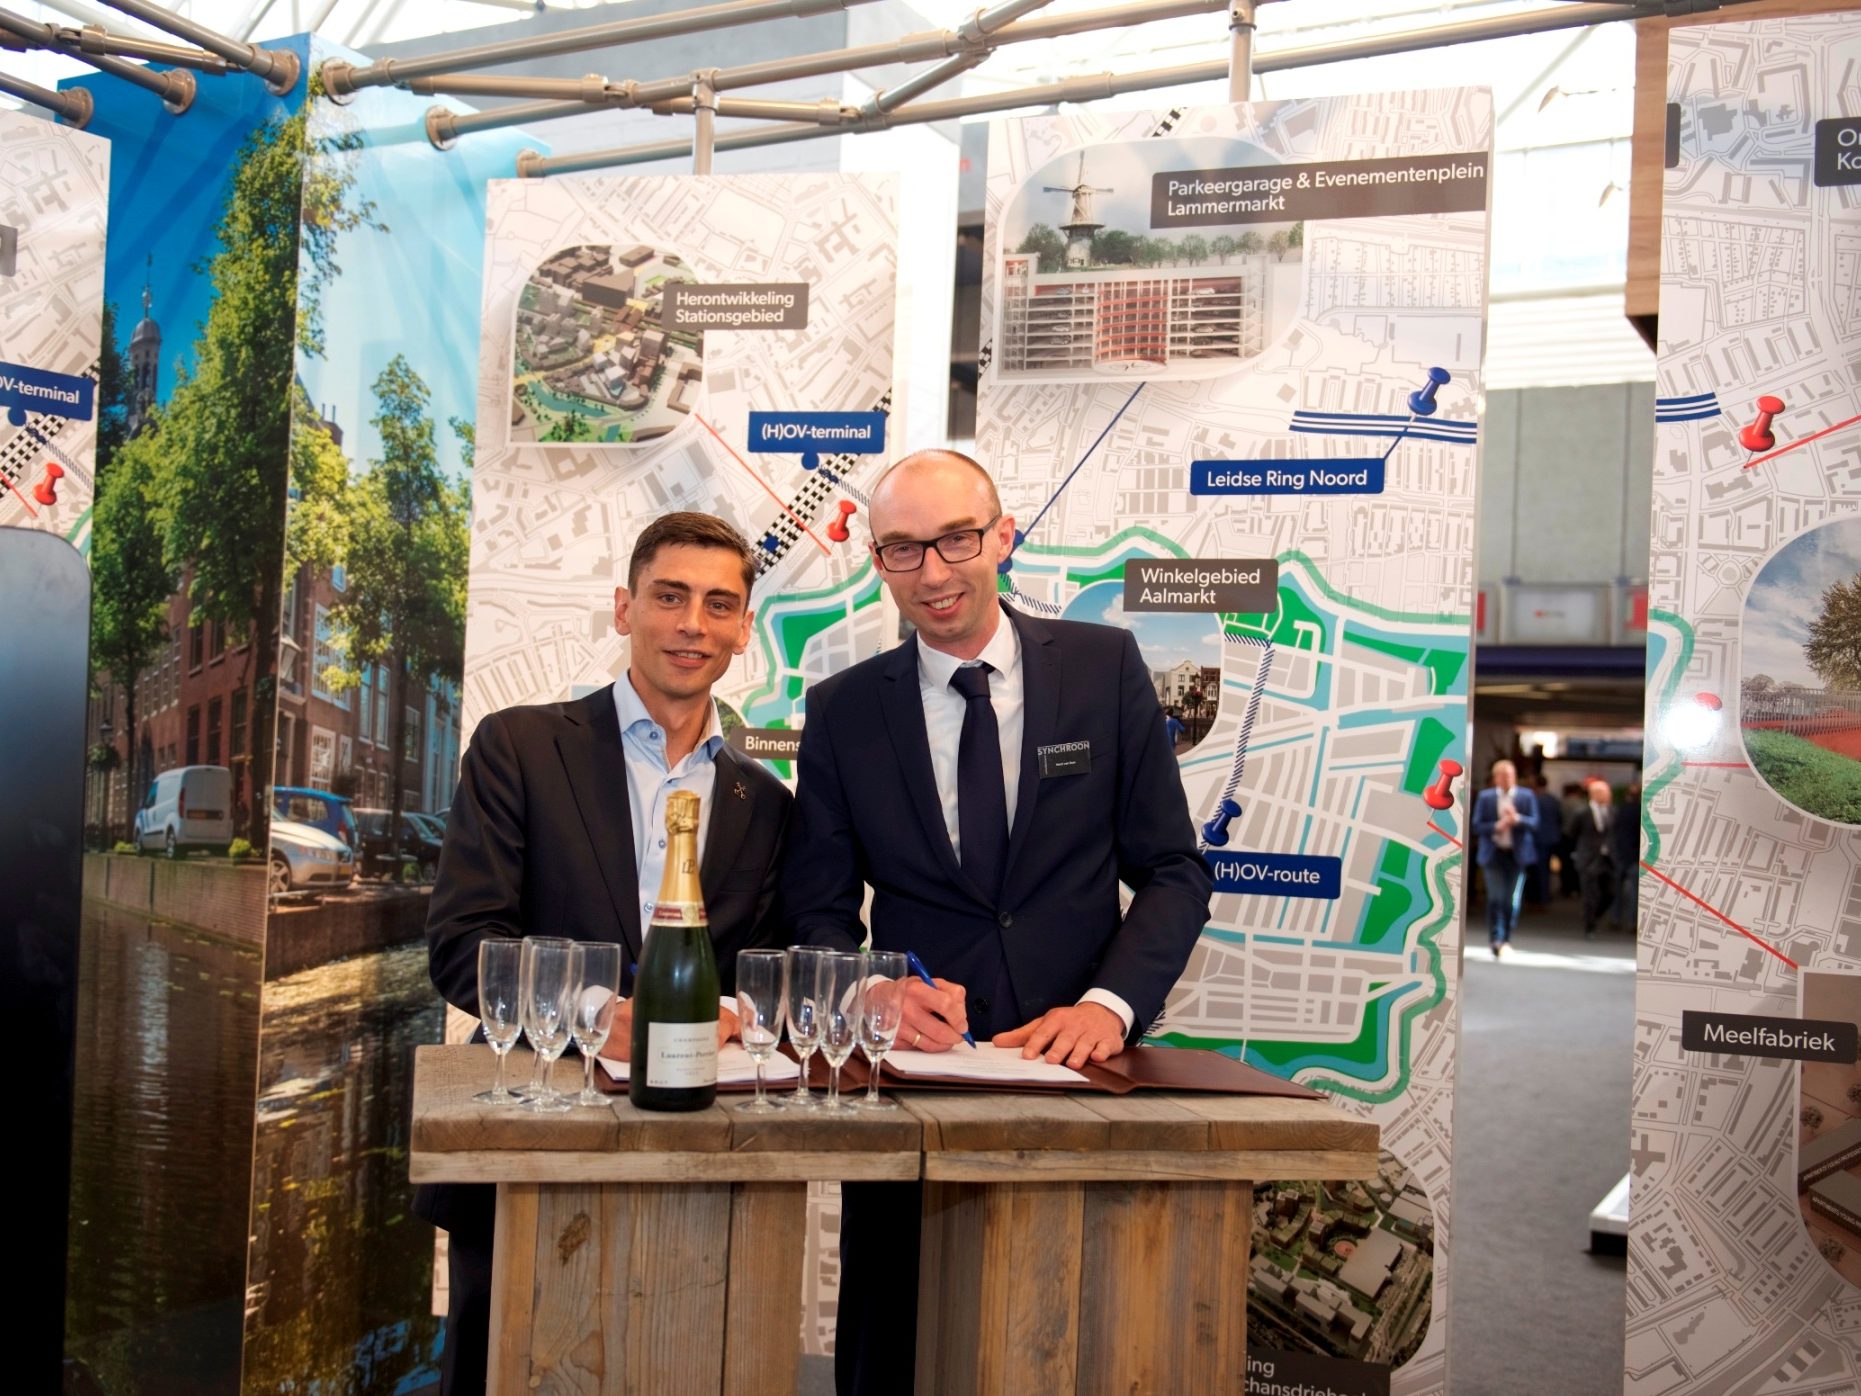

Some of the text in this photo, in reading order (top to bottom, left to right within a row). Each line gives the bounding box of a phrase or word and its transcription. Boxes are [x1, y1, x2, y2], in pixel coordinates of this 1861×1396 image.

[1838, 128, 1861, 147] O
[1168, 163, 1484, 198] Parkeergarage & Evenementenplein
[1167, 195, 1286, 216] Lammermarkt
[676, 292, 795, 308] Herontwikkeling
[675, 309, 784, 325] Stationsgebied
[762, 423, 871, 440] (H)OV-terminal
[1207, 469, 1368, 490] Leidse Ring Noord
[1141, 568, 1261, 587] Winkelgebied
[1139, 588, 1216, 604] Aalmarkt
[1037, 741, 1091, 755] SYNCHROON
[1214, 861, 1321, 884] (H)OV-route
[1703, 1023, 1836, 1051] Meelfabriek
